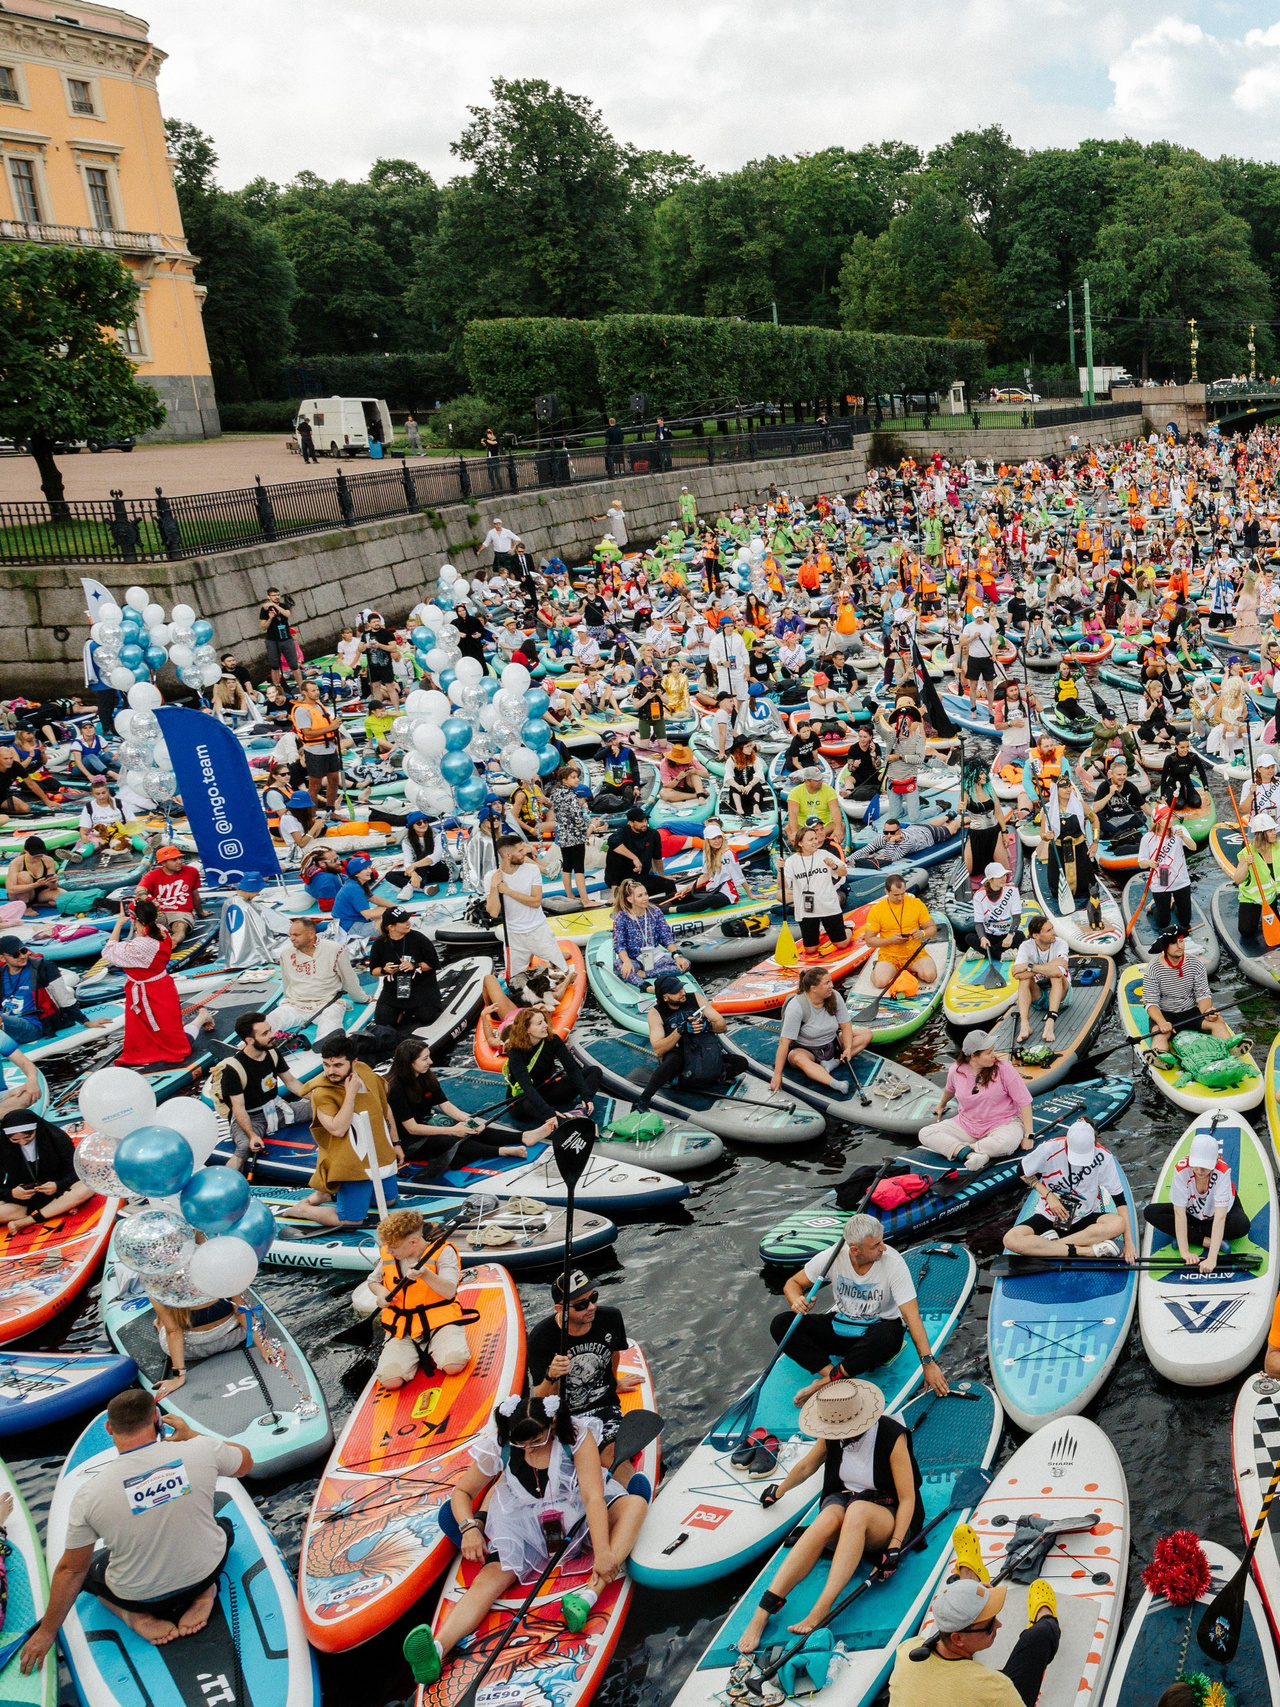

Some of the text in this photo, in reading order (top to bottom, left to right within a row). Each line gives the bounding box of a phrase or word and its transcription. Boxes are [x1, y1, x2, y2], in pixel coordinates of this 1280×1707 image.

[202, 743, 234, 836] @ingo.team
[133, 1476, 183, 1502] 04401
[681, 1509, 724, 1526] red
